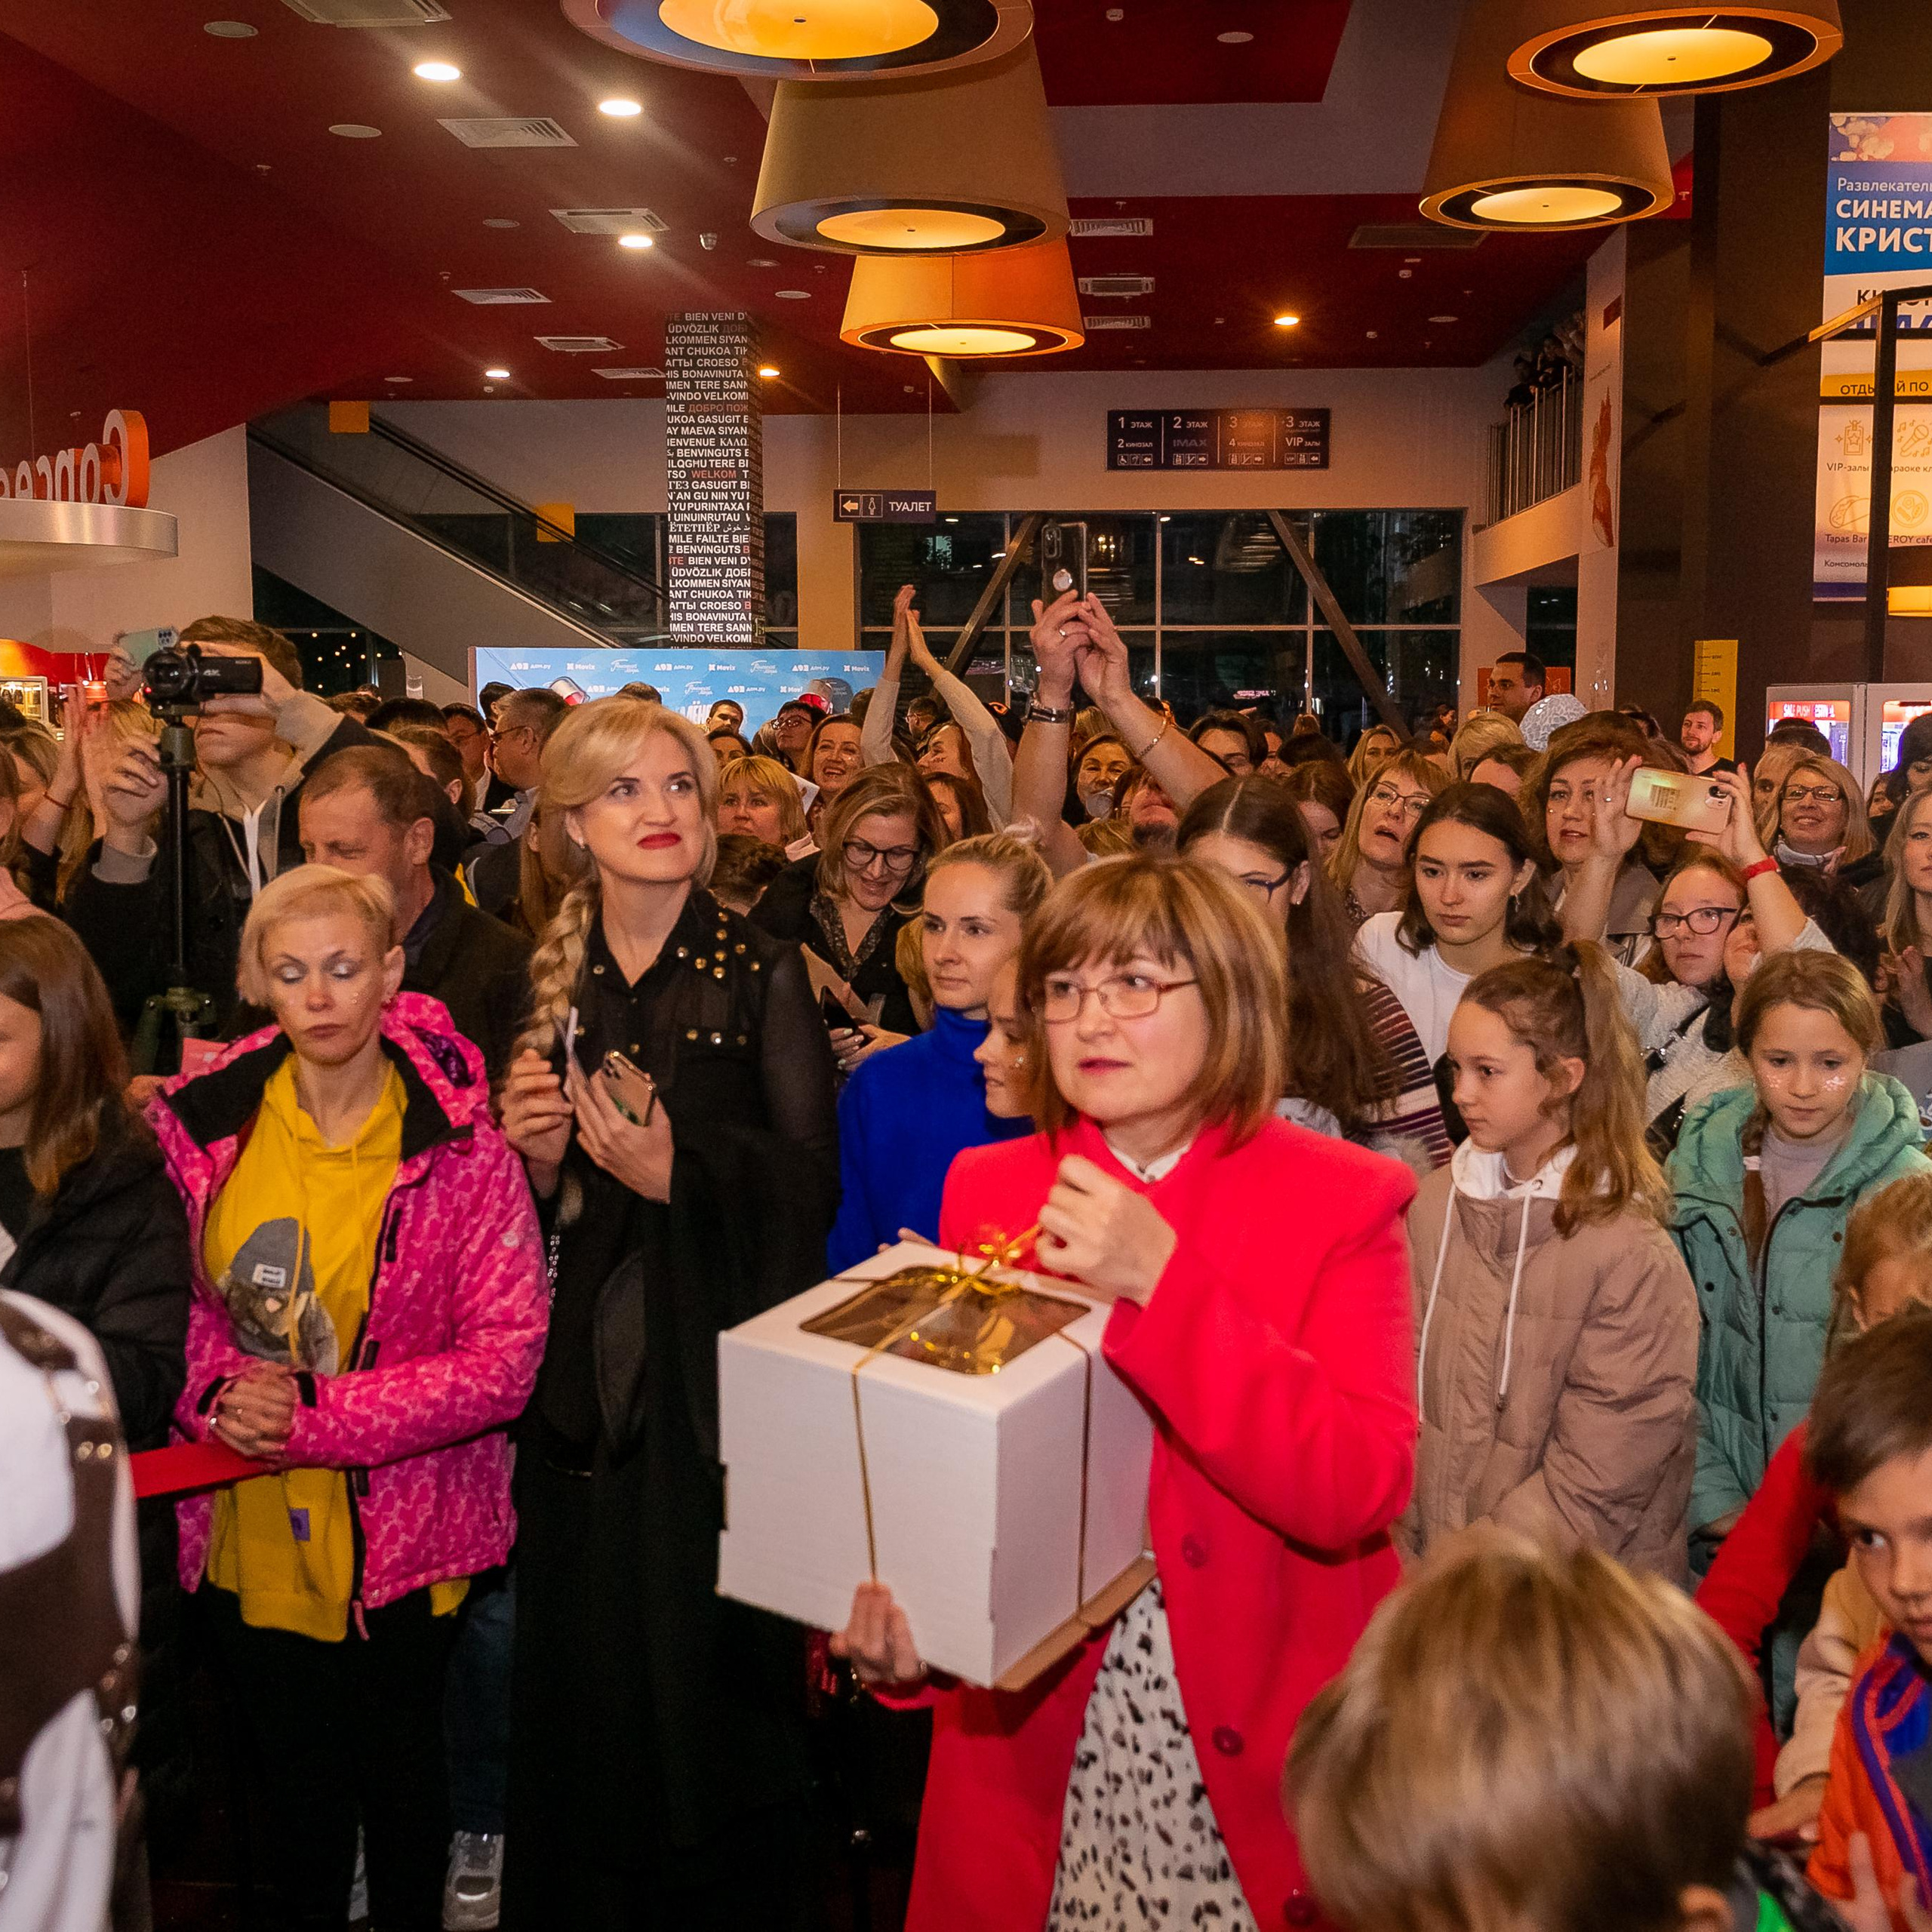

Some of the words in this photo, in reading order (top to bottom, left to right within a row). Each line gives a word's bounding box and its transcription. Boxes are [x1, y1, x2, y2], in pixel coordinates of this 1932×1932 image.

[685, 312, 709, 321] BIEN
[711, 312, 734, 321] VENI
[687, 347, 731, 355] CHUKOA
[697, 358, 739, 367] CROESO
[682, 370, 744, 378] BONAVINUTA
[694, 381, 720, 389] TERE
[1909, 382, 1928, 392] ПО
[688, 404, 724, 413] ДОБРО
[697, 415, 740, 423] GASUGIT
[1118, 417, 1124, 429] 1
[1173, 417, 1182, 429] 2
[1229, 417, 1238, 428] 3
[1286, 416, 1294, 428] 3
[681, 426, 716, 435] MAEVA
[1117, 438, 1124, 448] 2
[1229, 438, 1236, 447] 4
[1285, 437, 1303, 447] VIP
[677, 448, 742, 457] BENVINGUTS
[709, 459, 735, 468] TERE
[1826, 463, 1869, 472] VIP-залы
[691, 470, 737, 478] WELKOM
[691, 481, 738, 490] GASUGIT
[694, 491, 709, 500] GU
[711, 491, 728, 500] NIN
[730, 491, 744, 500] YU
[889, 502, 932, 512] ТУАЛЕТ
[669, 534, 693, 543] MILE
[696, 534, 729, 543] FAILTE
[1825, 534, 1850, 543] Tapas
[1852, 534, 1868, 543] Bar
[676, 545, 741, 554] BENVINGUTS
[688, 556, 712, 565] BIEN
[714, 556, 737, 565] VENI
[691, 590, 734, 598] CHUKOA
[700, 601, 742, 610] CROESO
[685, 613, 746, 621] BONAVINUTA
[697, 623, 724, 632] TERE
